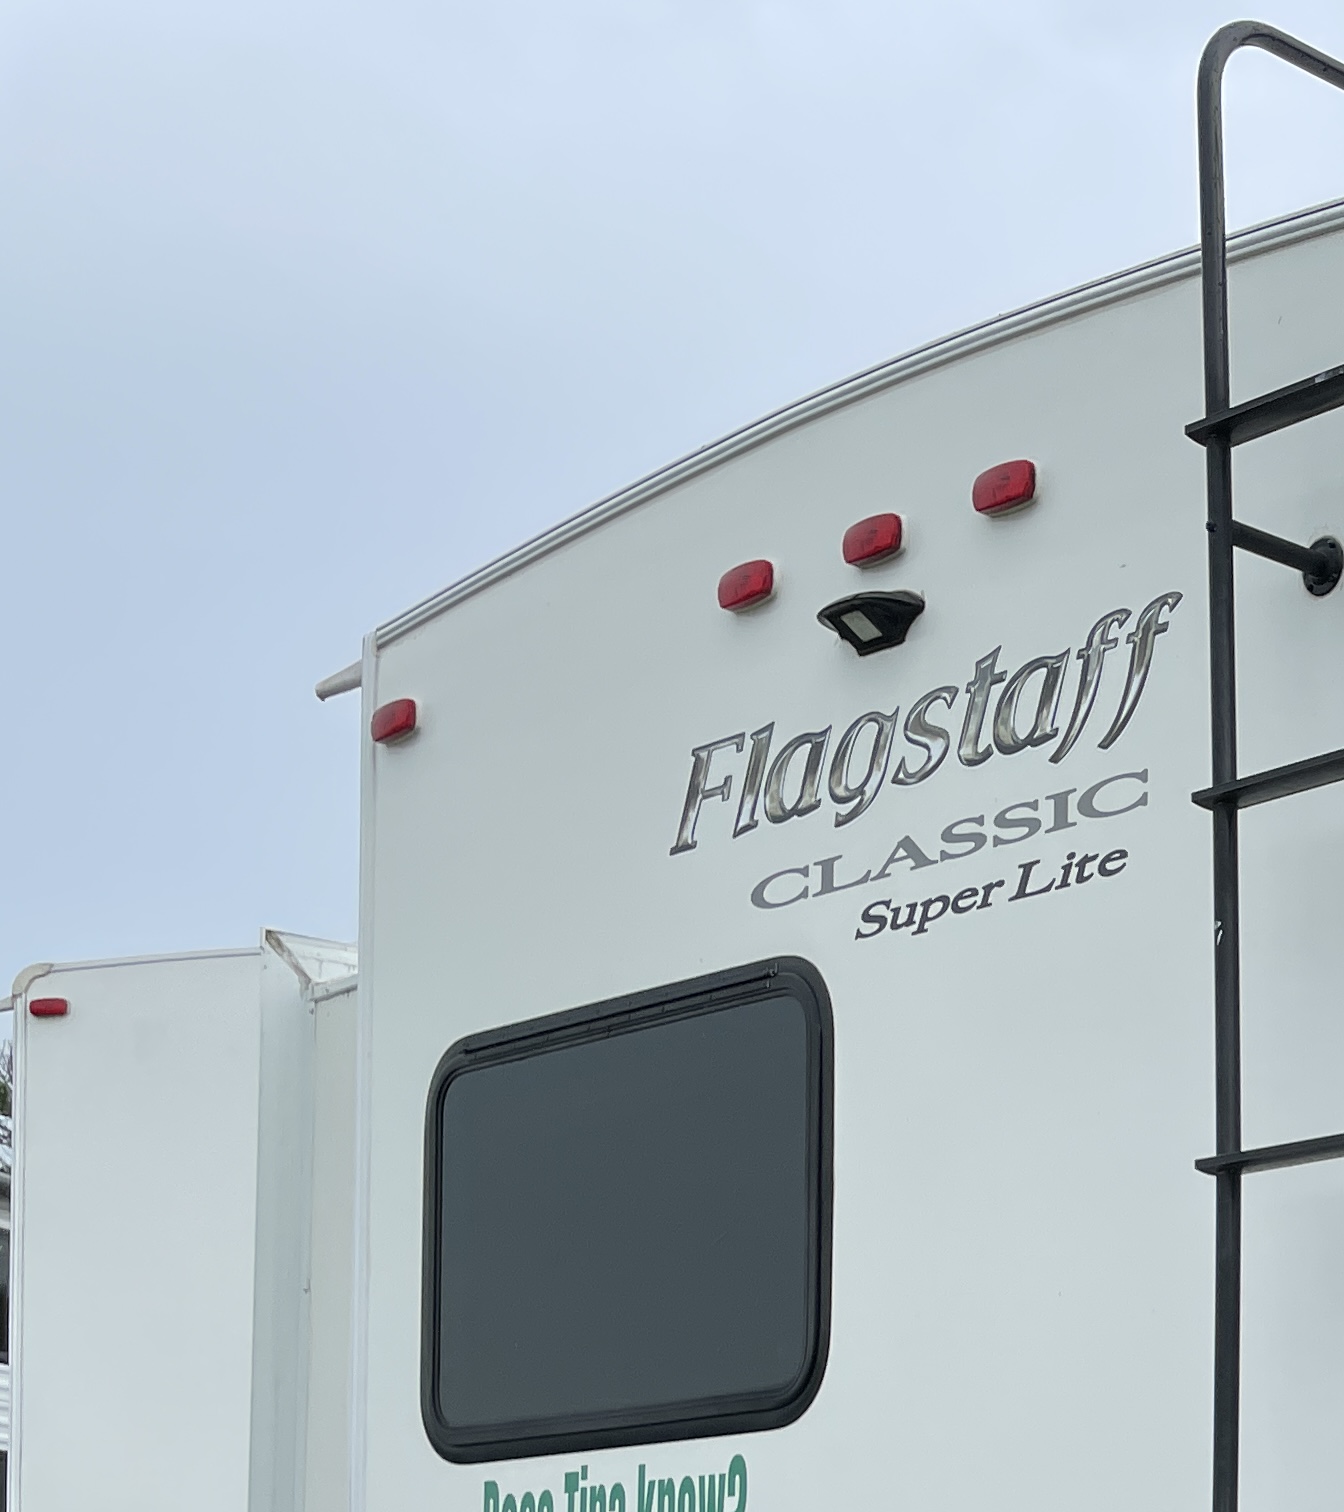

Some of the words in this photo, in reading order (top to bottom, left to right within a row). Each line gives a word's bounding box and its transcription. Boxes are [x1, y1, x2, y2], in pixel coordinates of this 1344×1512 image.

[669, 591, 1183, 856] Flagstaff
[750, 769, 1149, 910] CLASSIC
[855, 880, 1004, 941] Super
[1008, 848, 1128, 903] Lite
